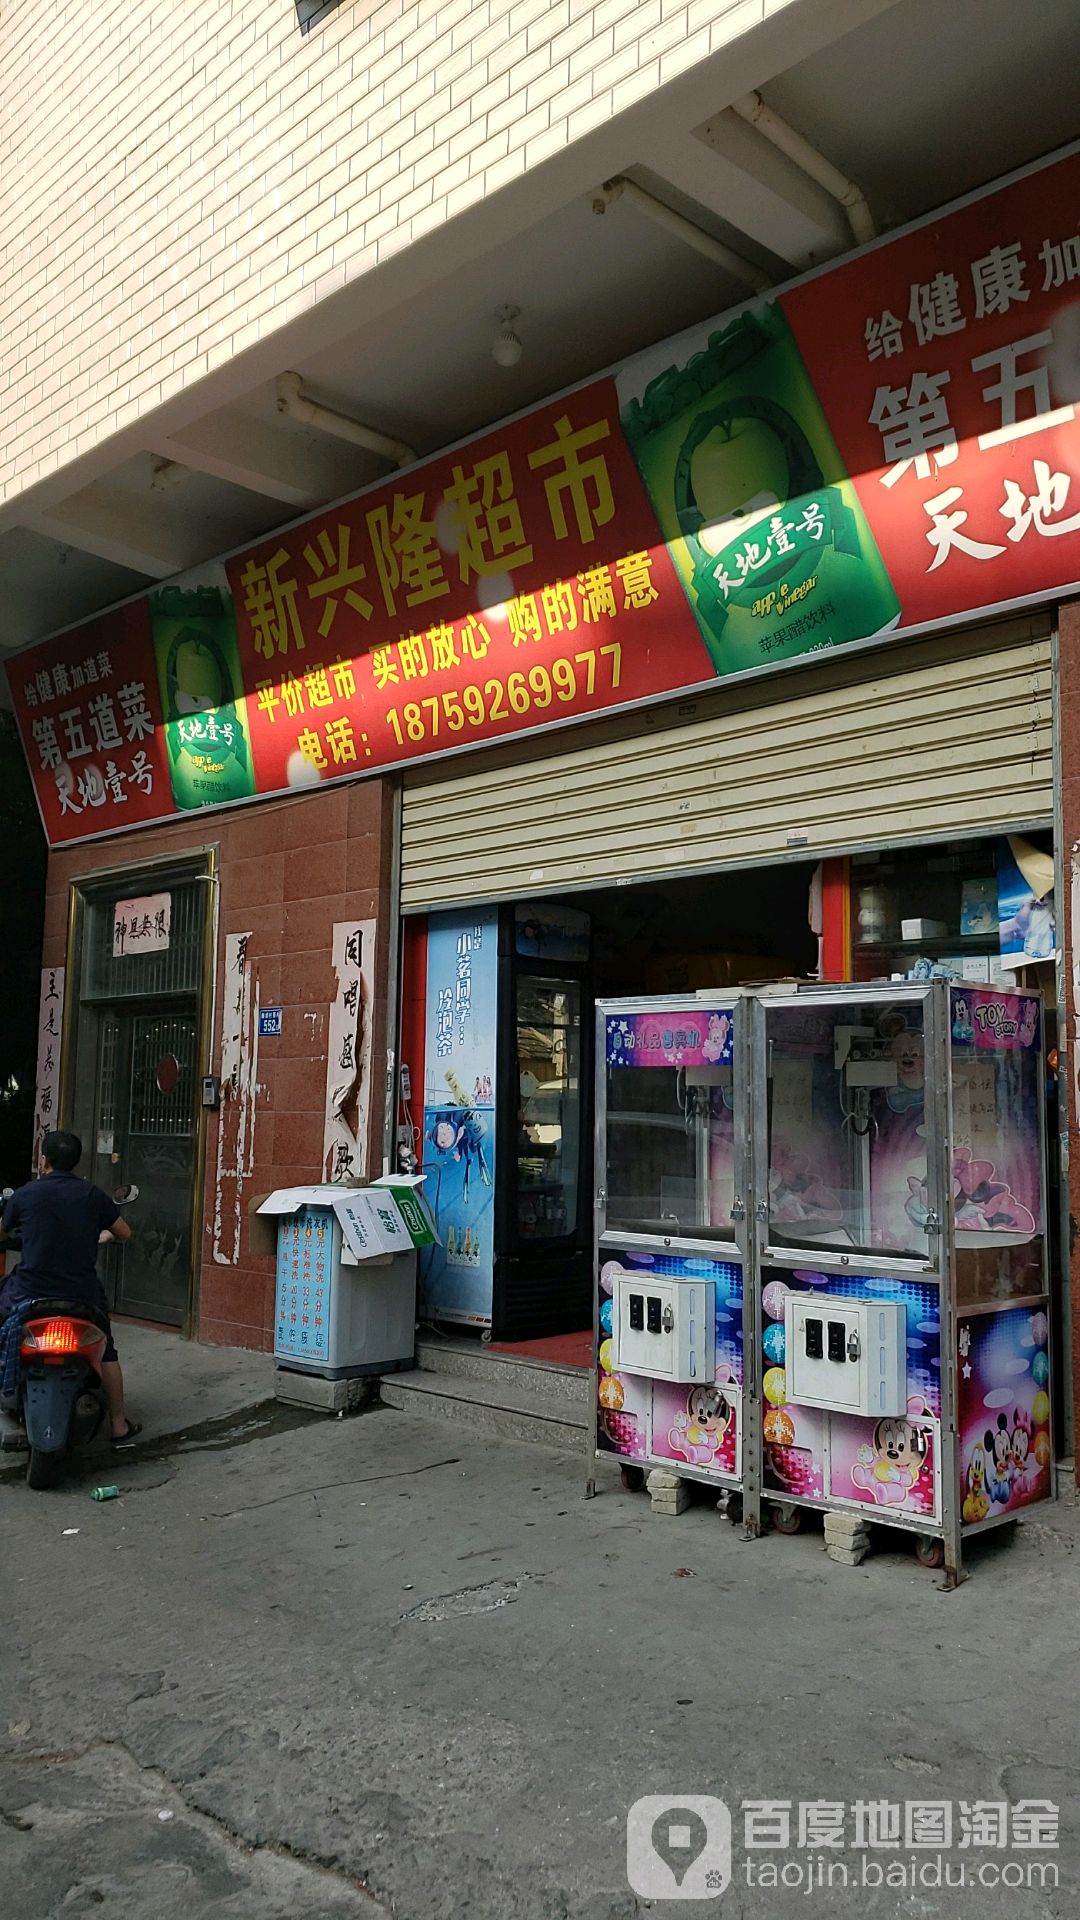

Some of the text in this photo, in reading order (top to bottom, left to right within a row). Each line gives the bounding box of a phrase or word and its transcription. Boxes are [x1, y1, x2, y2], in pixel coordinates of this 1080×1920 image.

[864, 235, 1080, 361] 给健康加
[869, 329, 1076, 489] 第五
[240, 415, 615, 660] 新兴隆超市
[712, 503, 826, 600] 天地壹号
[924, 459, 1080, 573] 天地
[758, 601, 836, 653] 苹果醋饮料
[775, 575, 818, 616] vinegar
[256, 550, 660, 724] 平价超市 买的放心 购的满意
[24, 651, 113, 707] 给健康加道菜
[386, 642, 622, 745] 18759269977
[32, 681, 155, 771] 第五道菜
[178, 715, 235, 746] 天地壹号
[56, 750, 154, 816] 天地壹号
[436, 986, 453, 1058] 冷泡茶
[975, 1003, 1006, 1032] TOY
[995, 1020, 1018, 1039] STORY
